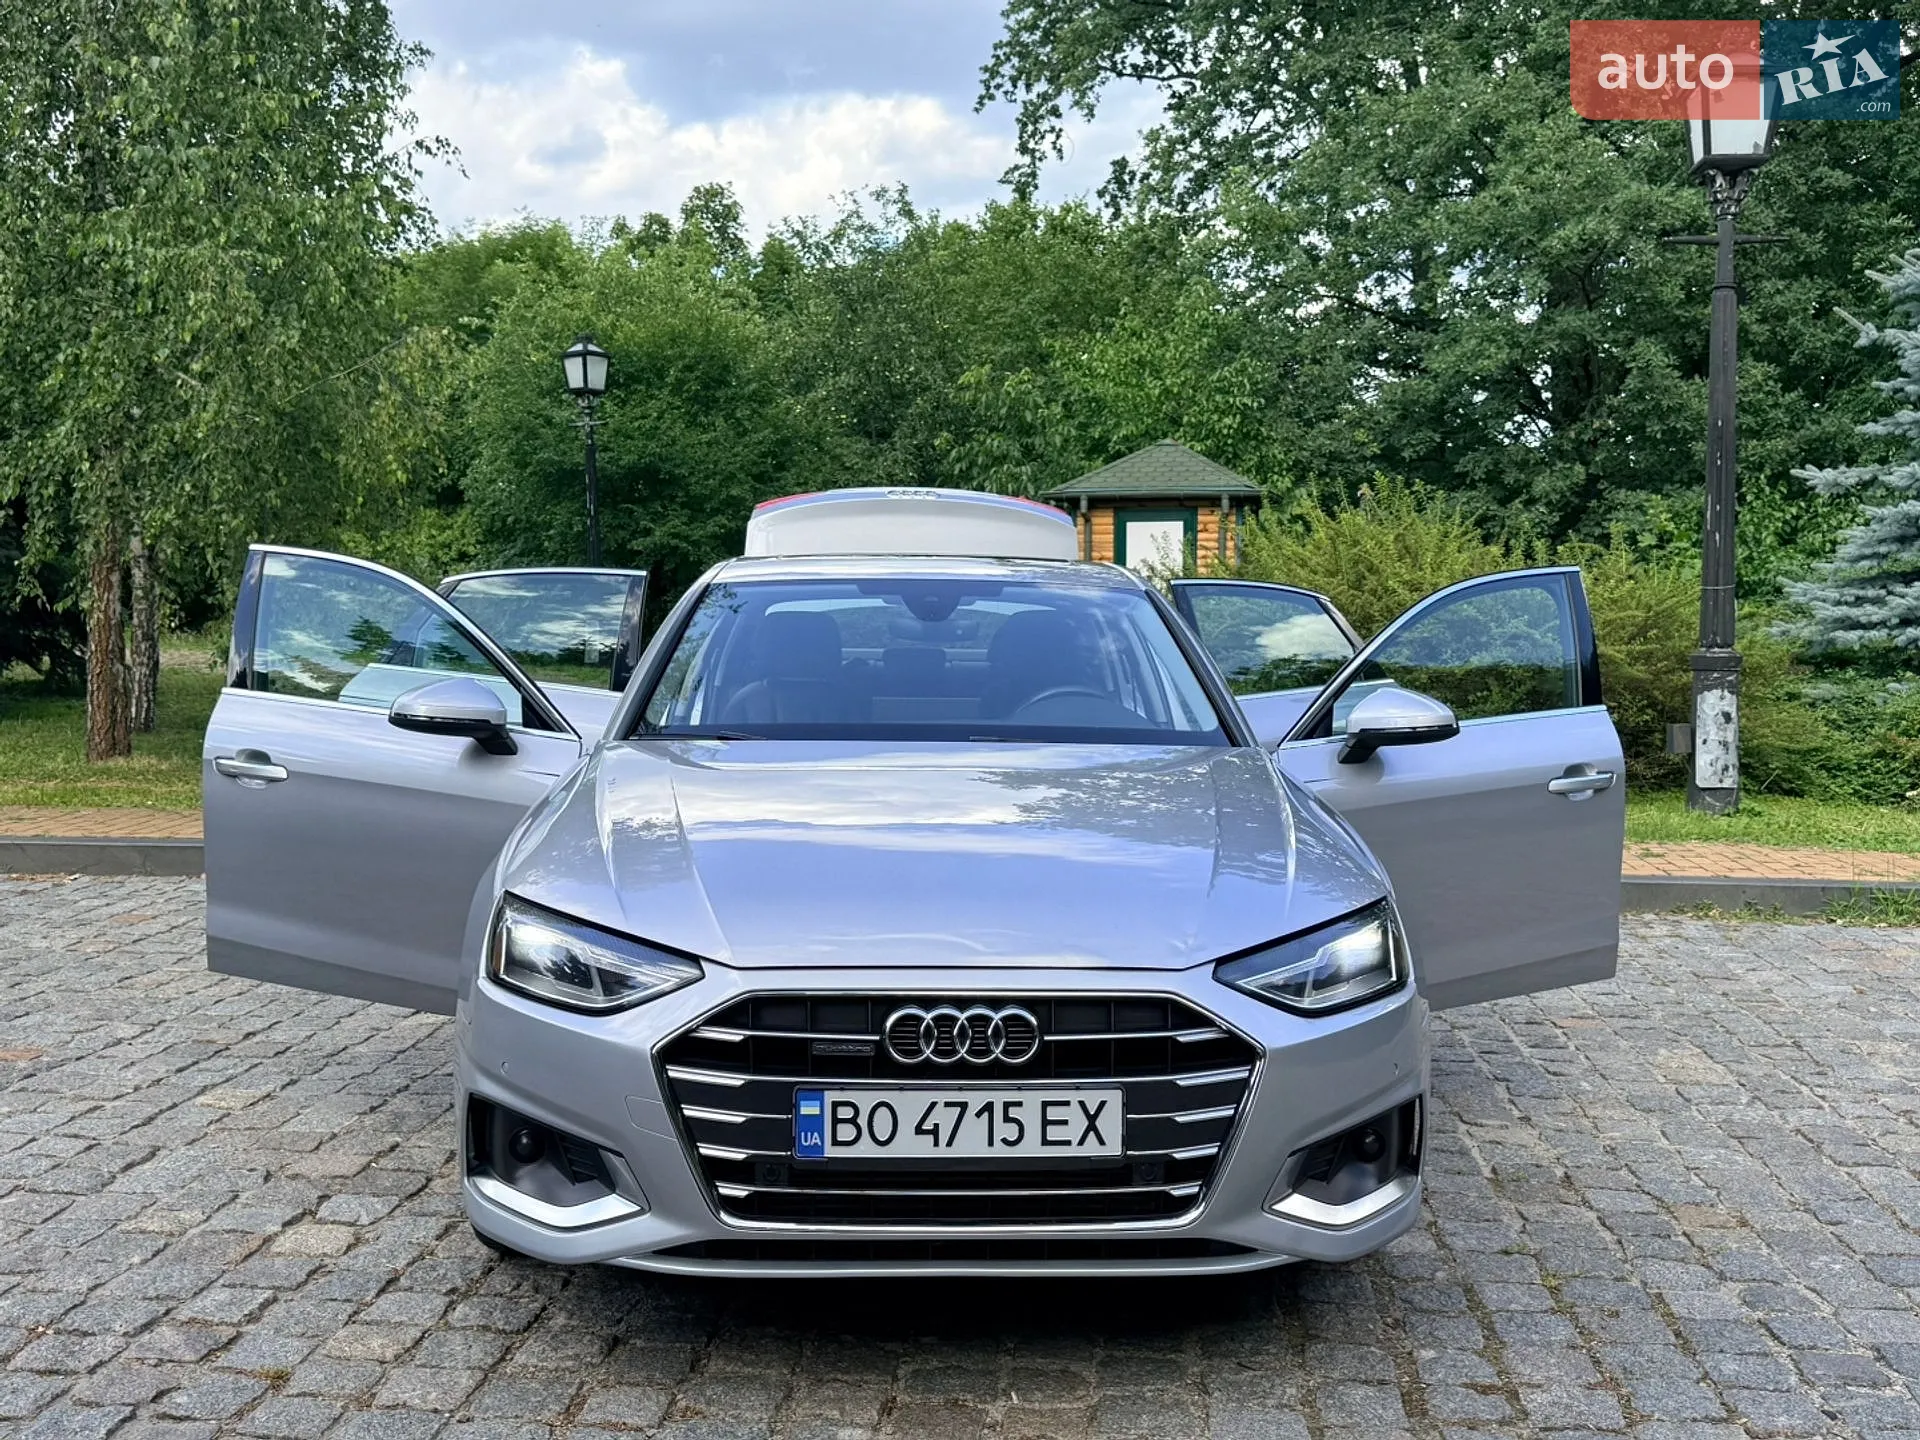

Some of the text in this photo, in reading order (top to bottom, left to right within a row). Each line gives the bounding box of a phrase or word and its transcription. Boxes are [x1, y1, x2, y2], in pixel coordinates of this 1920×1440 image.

[830, 1099, 1108, 1147] BO 4715 EX
[801, 1133, 821, 1146] UA
